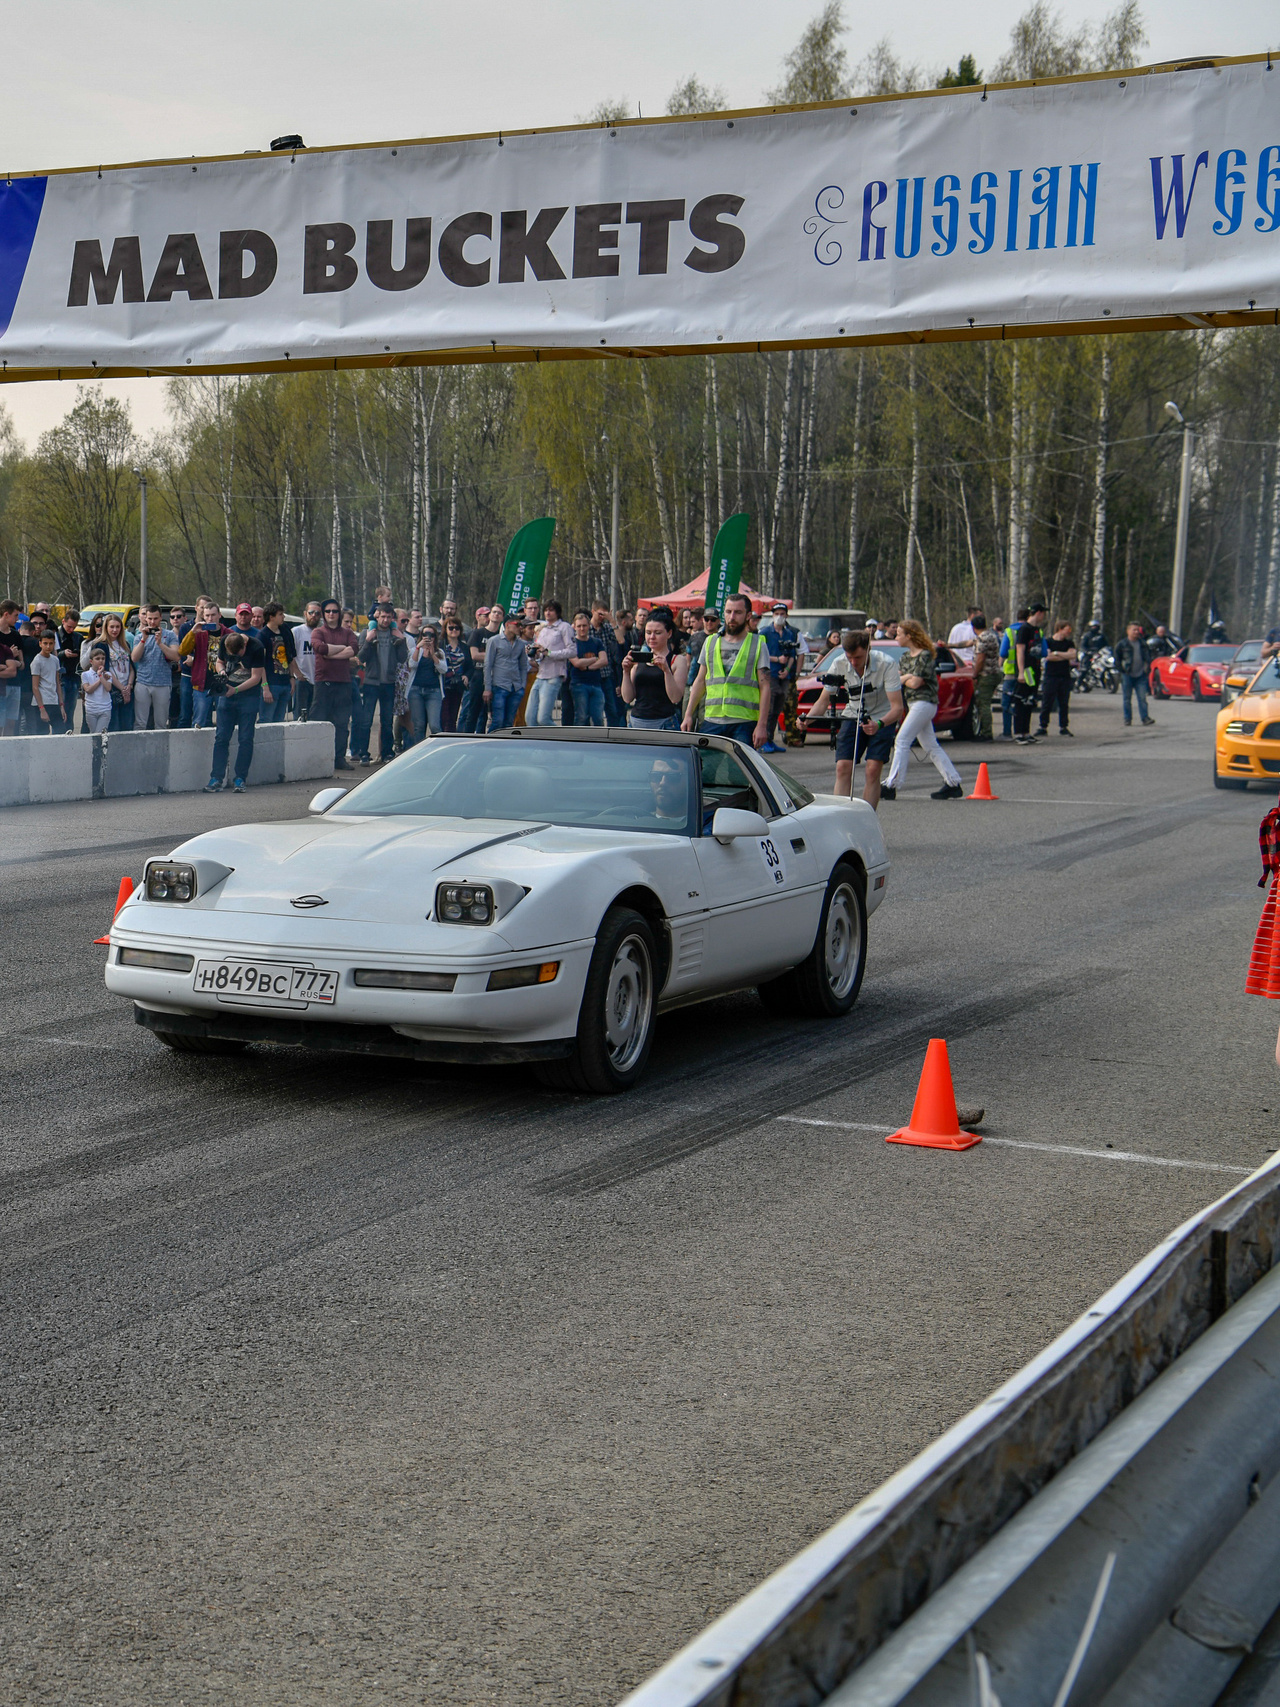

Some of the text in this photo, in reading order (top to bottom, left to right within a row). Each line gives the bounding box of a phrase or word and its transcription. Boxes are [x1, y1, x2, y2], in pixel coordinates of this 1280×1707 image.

[67, 194, 746, 307] MAD BUCKETS
[508, 561, 526, 615] REEDOM
[761, 839, 780, 868] 33
[294, 970, 331, 991] 777
[300, 991, 319, 999] RUS
